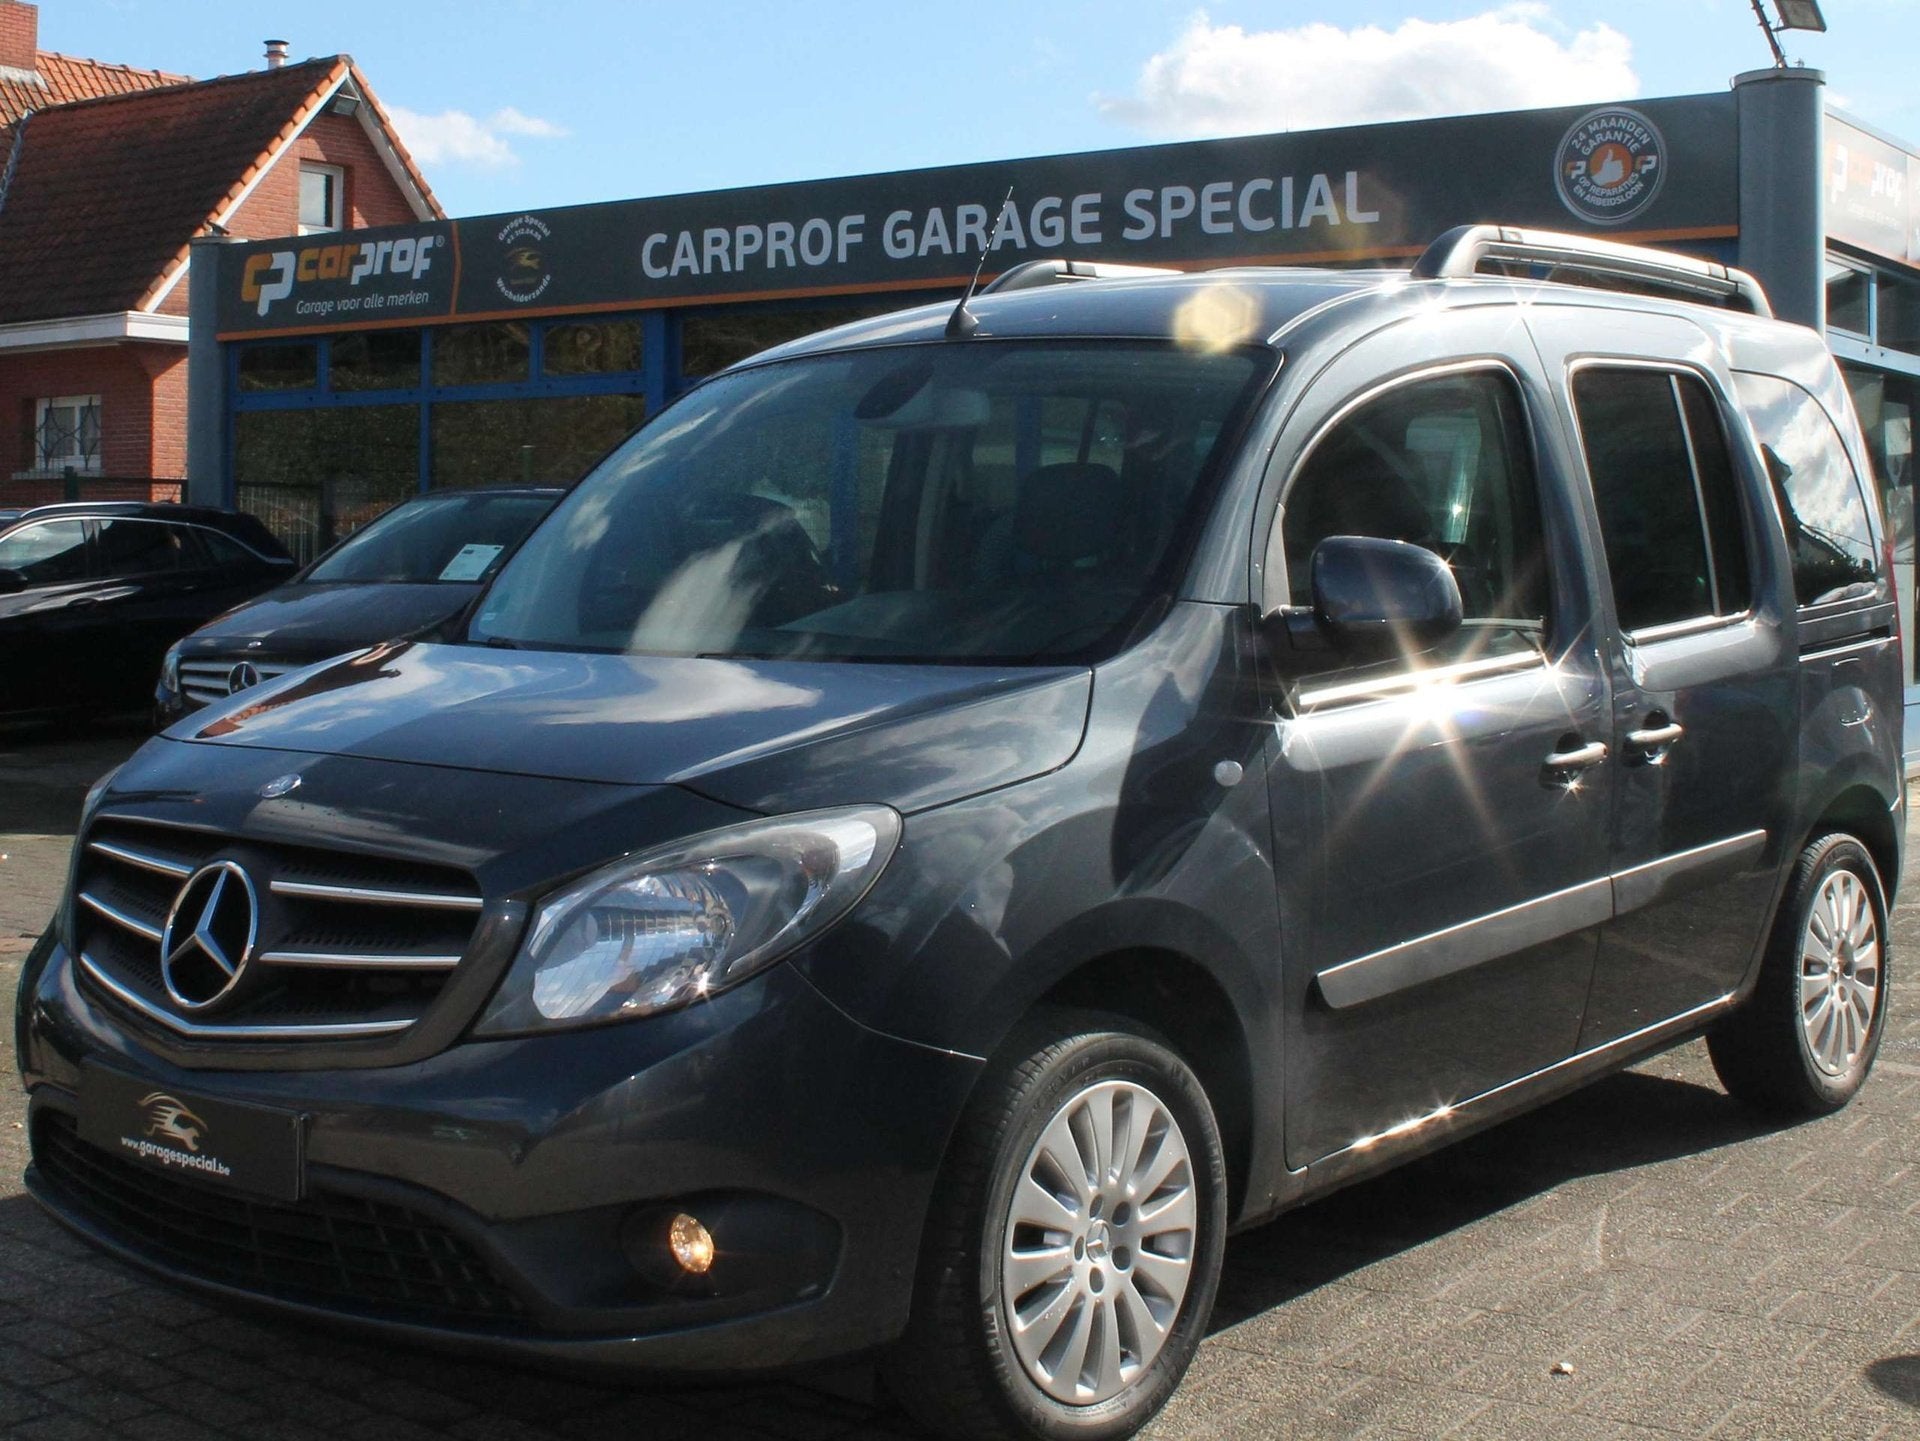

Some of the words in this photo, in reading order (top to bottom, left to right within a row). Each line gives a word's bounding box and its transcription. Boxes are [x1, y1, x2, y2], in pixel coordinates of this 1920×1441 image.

[1571, 132, 1586, 149] 24
[1587, 117, 1651, 145] MAANDEN
[1581, 130, 1642, 156] GARANTIE
[524, 215, 551, 237] Special
[641, 214, 866, 280] CARPROF
[882, 192, 1102, 259] GARAGE
[1122, 170, 1380, 243] SPECIAL
[296, 299, 334, 316] Garage
[337, 298, 361, 311] voor
[364, 293, 384, 308] alle
[387, 290, 429, 306] merken
[121, 1135, 230, 1176] www.garagespecial.be
